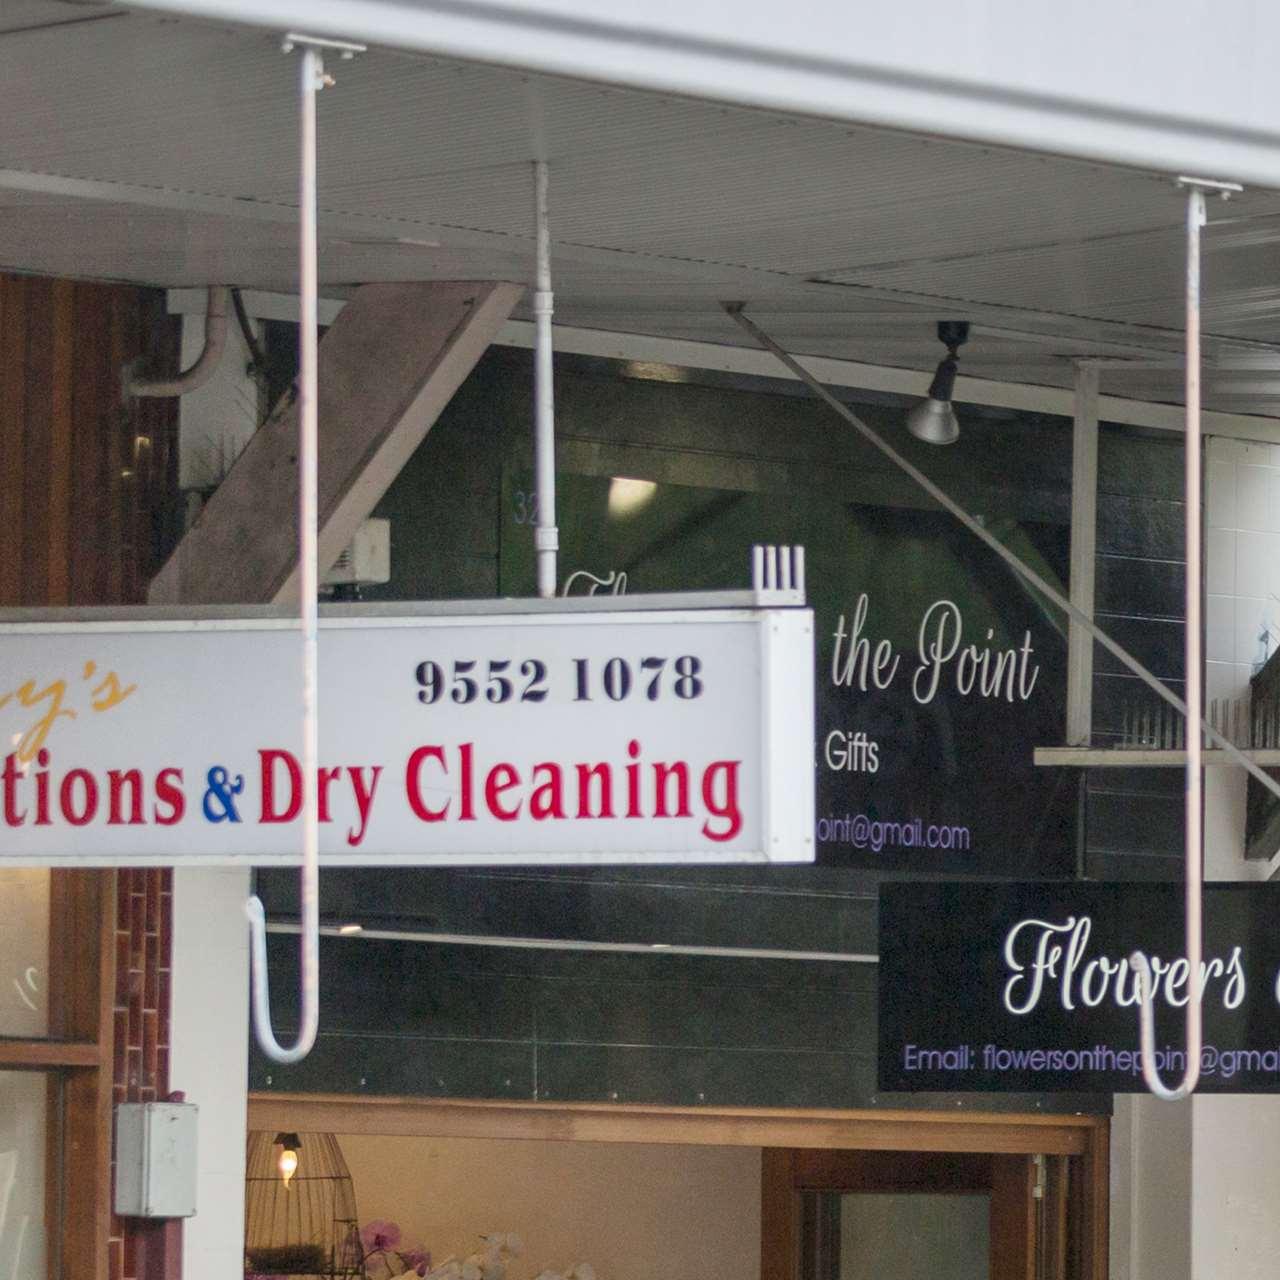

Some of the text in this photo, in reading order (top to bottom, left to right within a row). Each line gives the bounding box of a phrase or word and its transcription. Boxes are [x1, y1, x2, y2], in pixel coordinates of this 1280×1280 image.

[415, 656, 704, 705] 9552 1078
[832, 594, 1040, 704] the Point
[0, 660, 137, 762] y's
[824, 729, 880, 774] Gifts
[200, 765, 245, 824] &
[257, 748, 384, 848] Dry
[404, 738, 743, 844] Cleaning
[815, 812, 971, 852] oint@gmail.com
[1004, 915, 1247, 1015] Flowers
[903, 1044, 976, 1072] Email:
